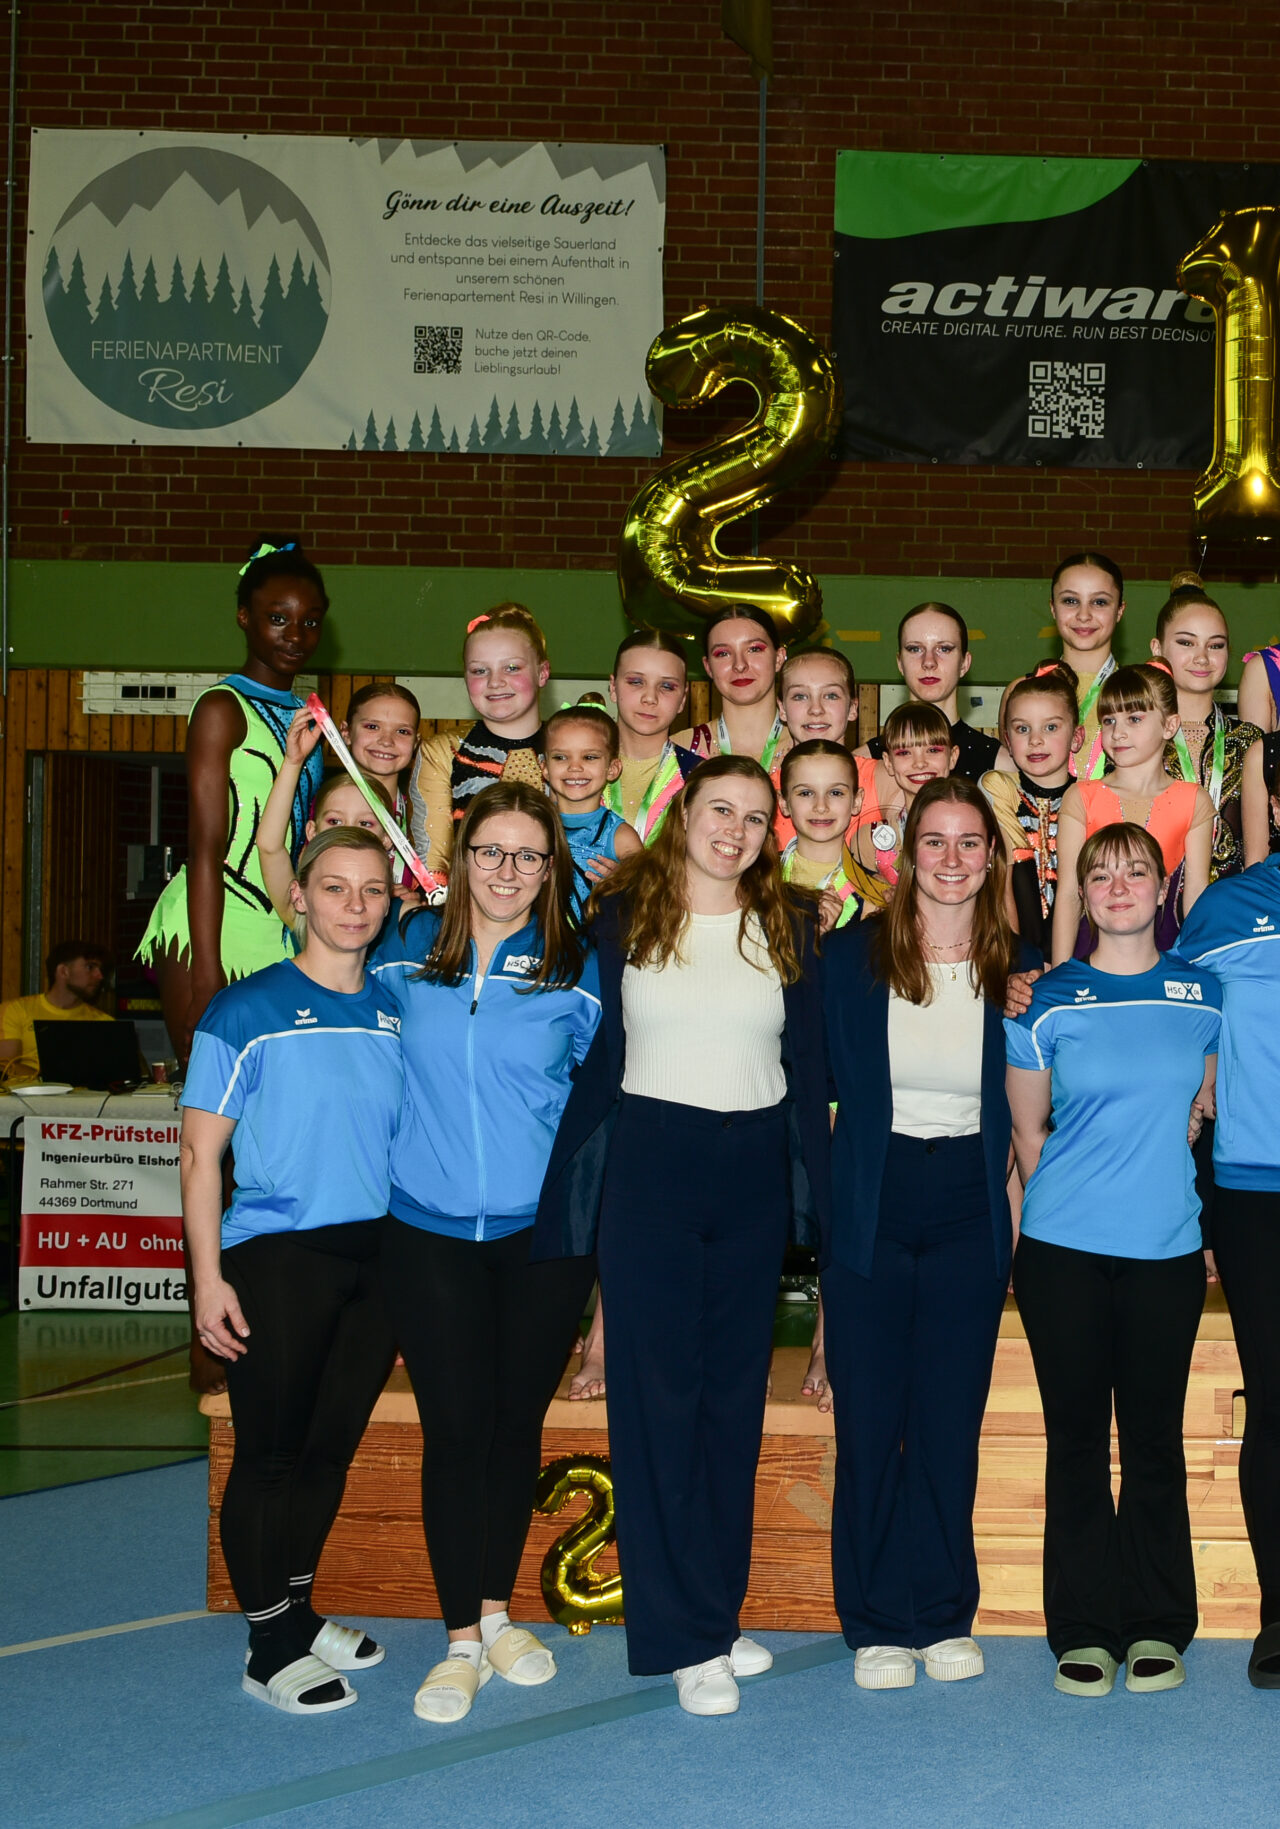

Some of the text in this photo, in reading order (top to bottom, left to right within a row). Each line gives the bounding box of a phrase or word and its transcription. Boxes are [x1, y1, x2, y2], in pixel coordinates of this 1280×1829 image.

[383, 190, 635, 224] Gönn dir eine Auszeit!
[404, 232, 616, 251] Entdecke das vielseitige Sauerland
[391, 252, 629, 269] und entspanne bei einem Aufenthalt in
[456, 272, 565, 285] unserem schönen
[404, 288, 619, 308] Ferienapartement Resi in Willingen.
[475, 329, 508, 340] Nutze
[511, 329, 533, 341] den
[881, 319, 939, 335] CREATE
[943, 321, 1000, 337] DIGITAL
[1005, 323, 1067, 339] FUTURE.
[1072, 325, 1104, 339] RUN
[1109, 326, 1148, 340] BEST
[91, 340, 283, 364] FERIENAPARTMENT
[475, 345, 578, 359] buche jetzt deinen
[474, 362, 561, 377] Lieblingsurlaub!
[138, 367, 234, 412] Resi
[1167, 985, 1184, 995] HSC
[41, 1123, 181, 1144] KFZ-Prüfstell
[41, 1151, 134, 1165] Ingenieurbüro
[40, 1178, 134, 1191] Rahmer Str. 271
[39, 1197, 138, 1209] 44369 Dortmund
[38, 1231, 70, 1249] HU
[77, 1234, 90, 1247] +
[95, 1232, 127, 1250] AU
